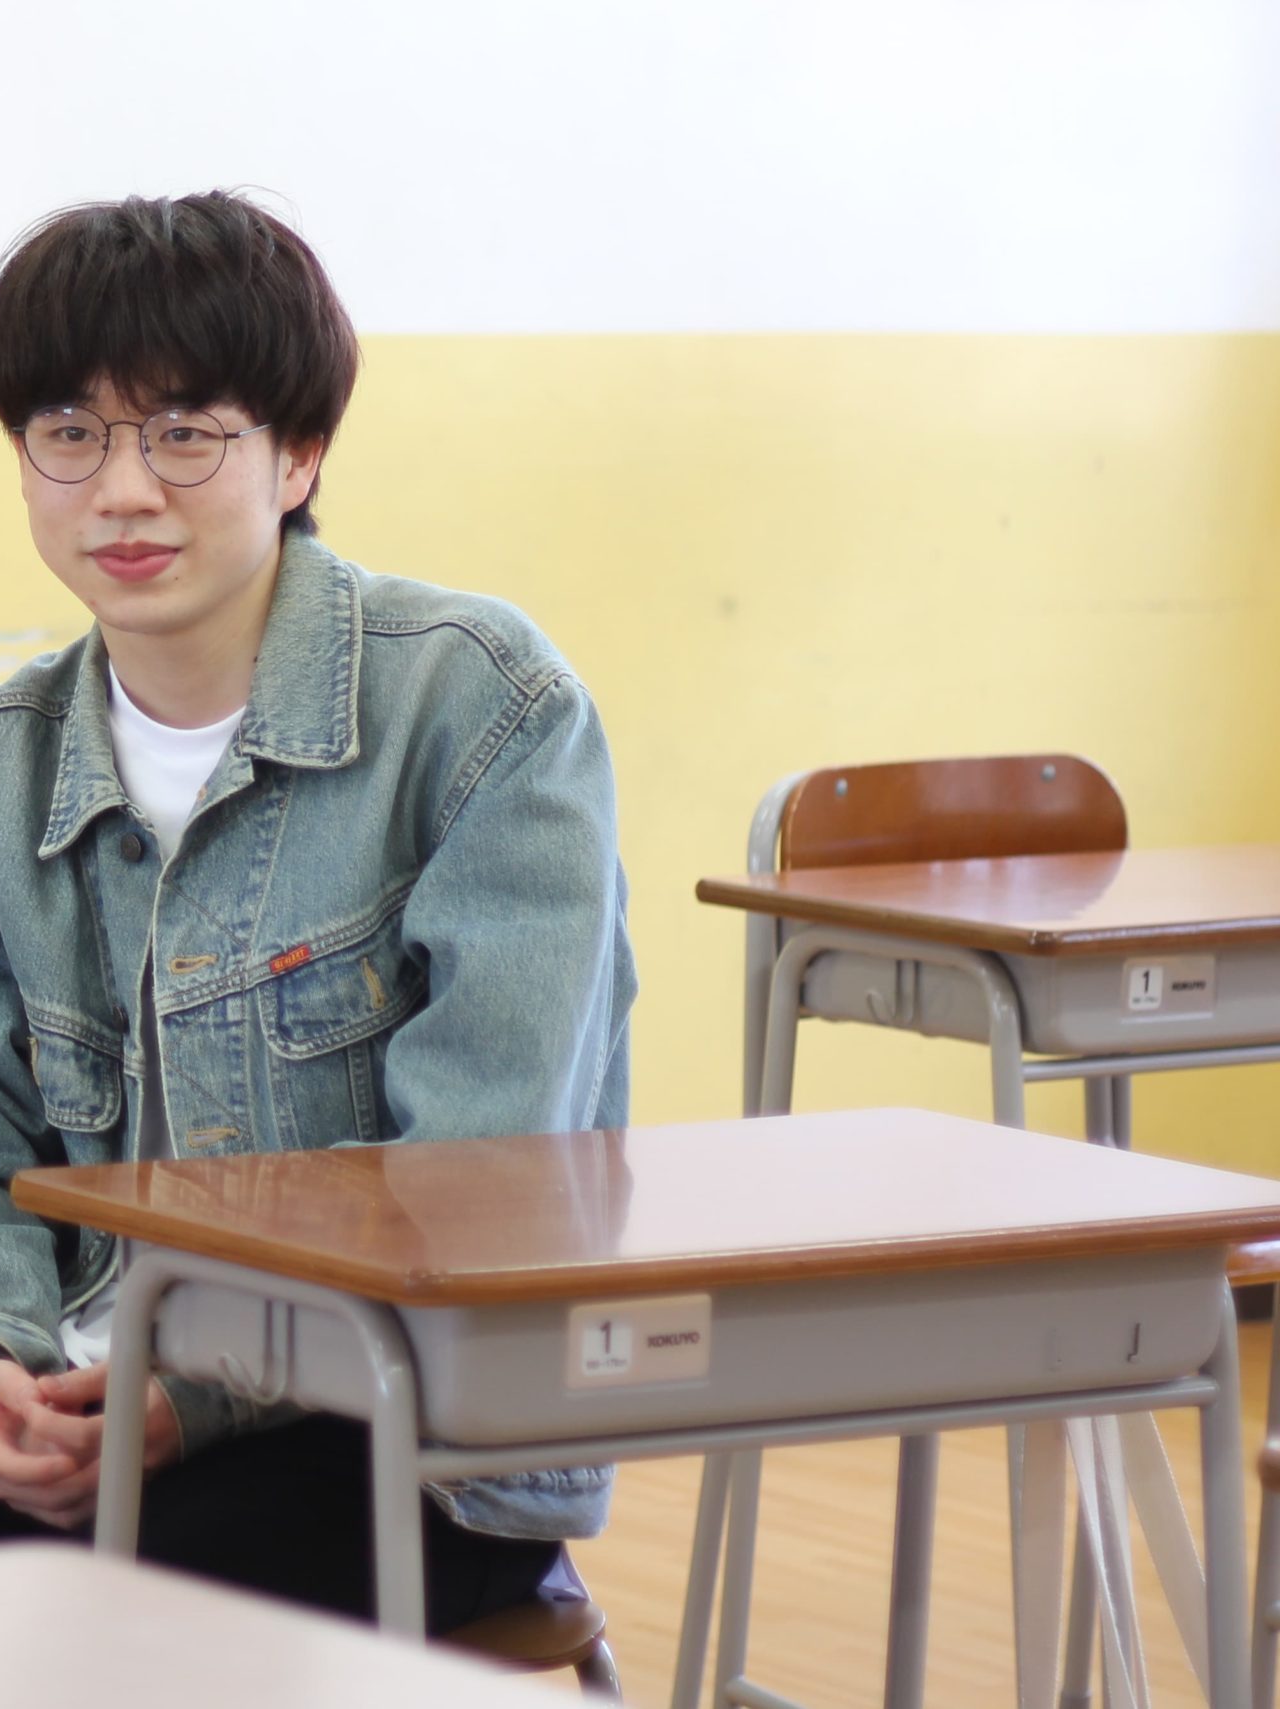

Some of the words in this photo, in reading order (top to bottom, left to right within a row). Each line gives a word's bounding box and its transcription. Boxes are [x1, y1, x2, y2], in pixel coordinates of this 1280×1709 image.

[1142, 969, 1150, 994] 1
[600, 1320, 612, 1354] 1
[647, 1332, 701, 1348] KOKUYO
